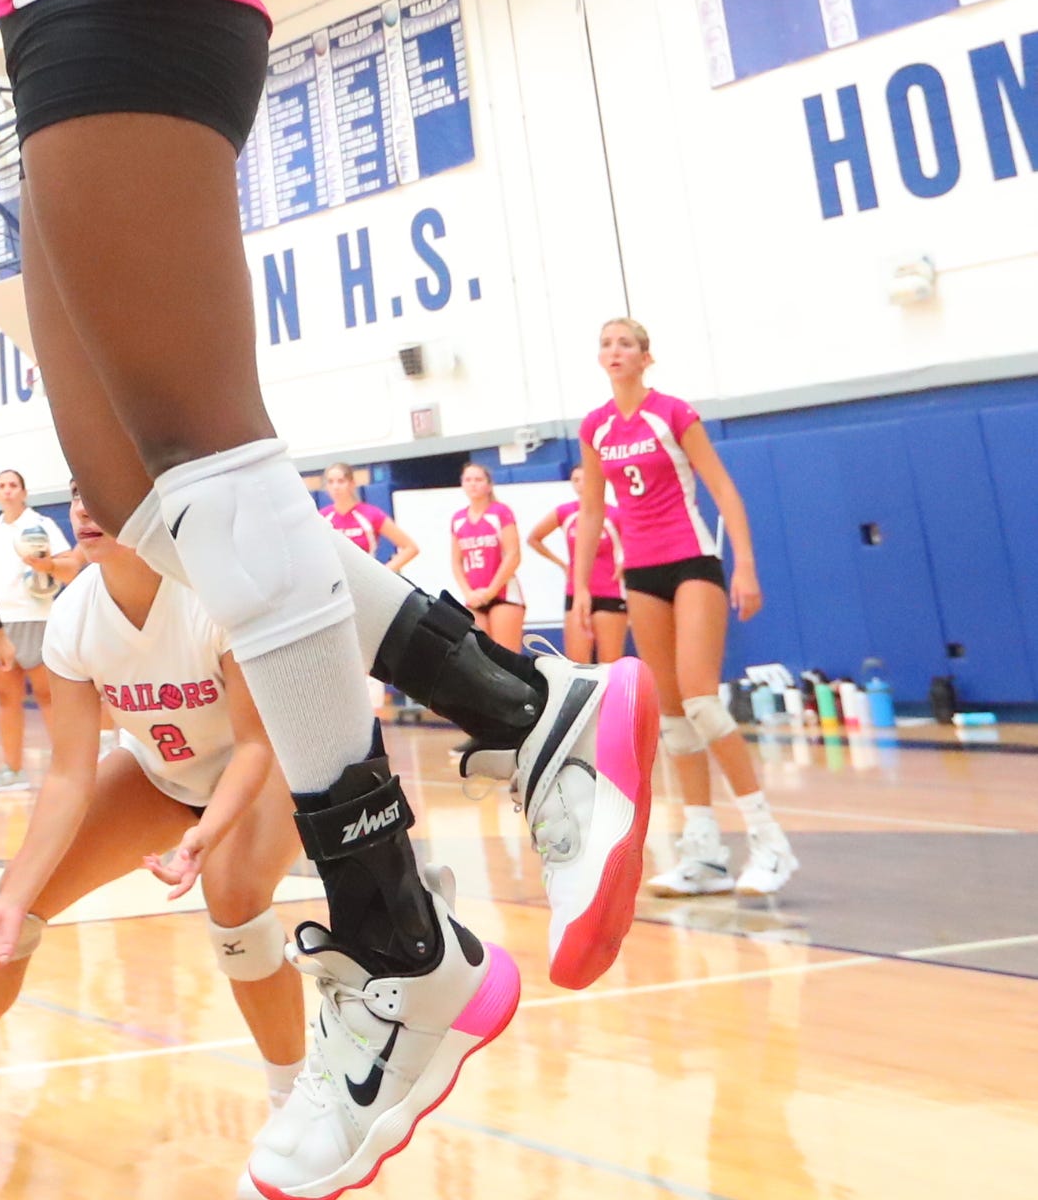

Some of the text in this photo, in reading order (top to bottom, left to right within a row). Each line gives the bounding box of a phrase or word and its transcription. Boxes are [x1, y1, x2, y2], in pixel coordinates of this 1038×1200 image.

[600, 437, 657, 461] SAILORS
[623, 465, 646, 497] 3
[102, 678, 219, 712] SAILORS
[150, 723, 195, 762] 2
[341, 800, 402, 845] ZAMST
